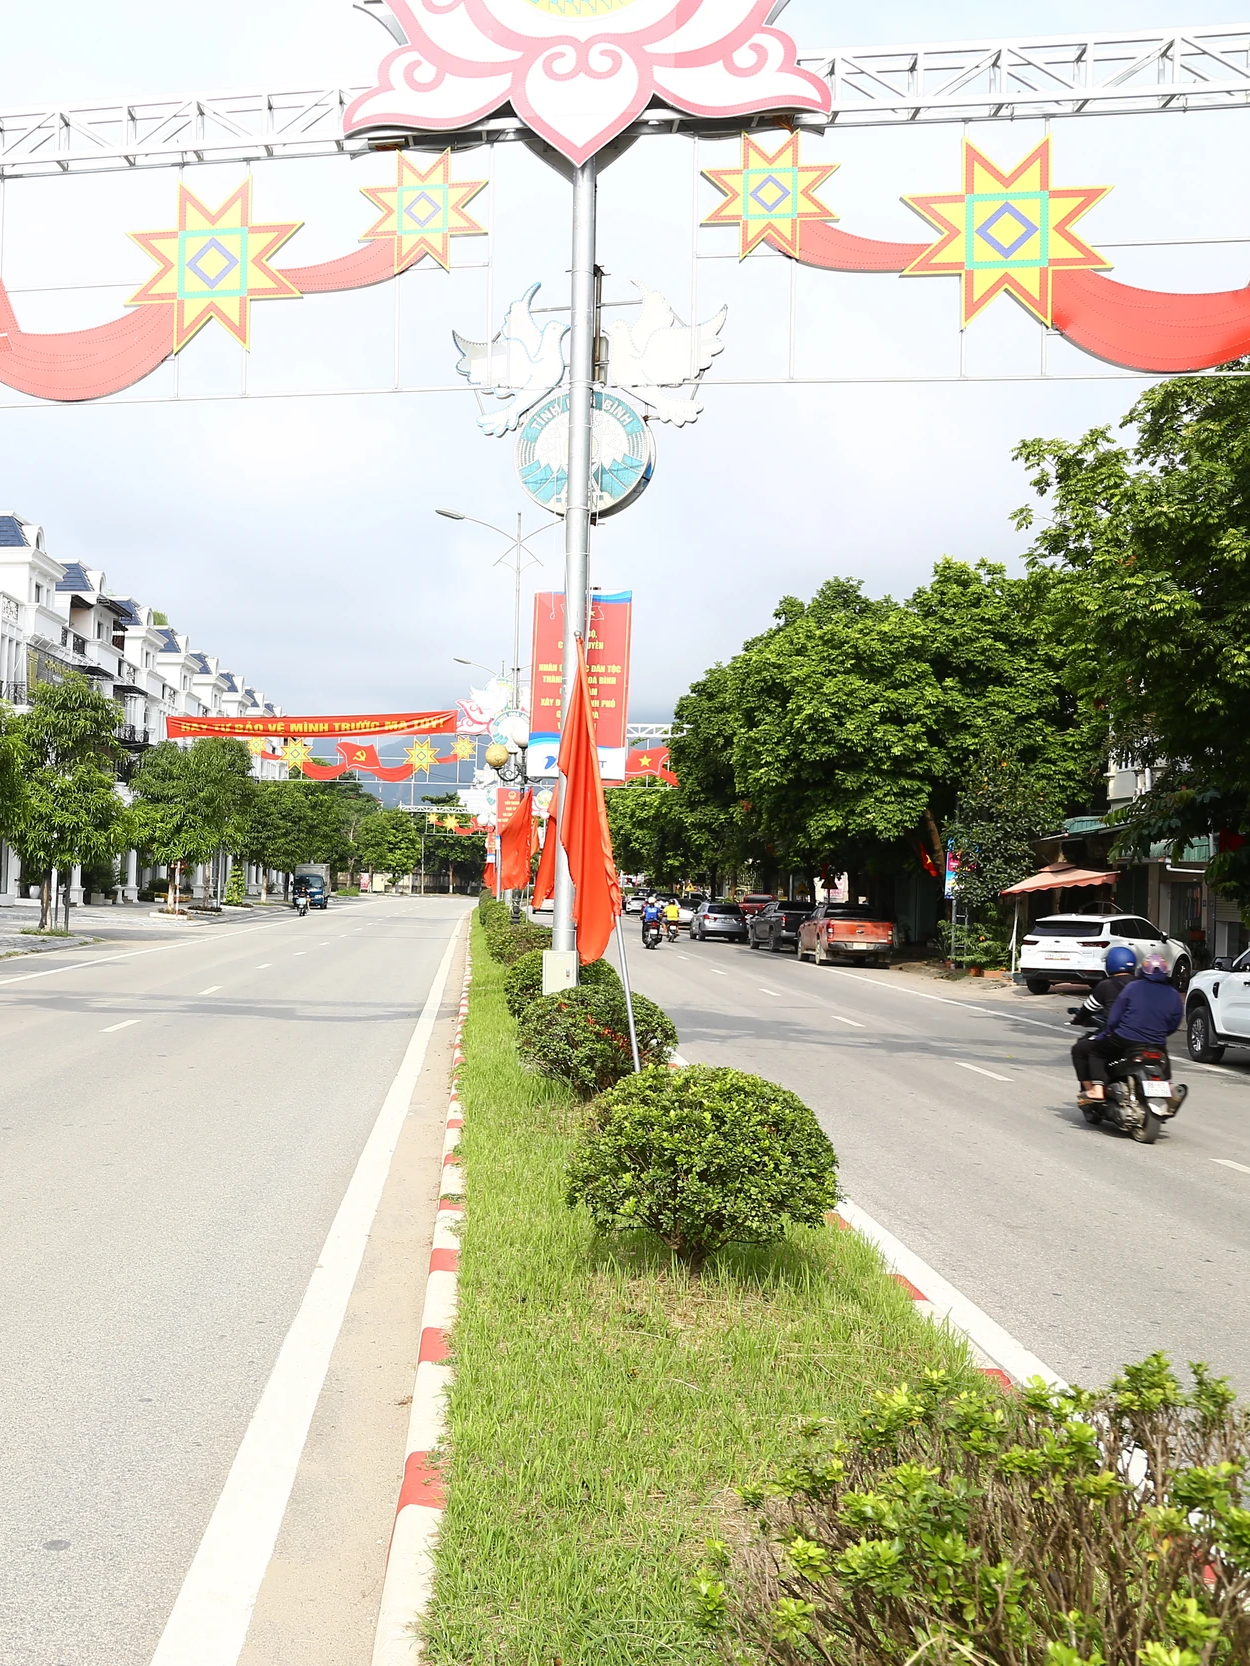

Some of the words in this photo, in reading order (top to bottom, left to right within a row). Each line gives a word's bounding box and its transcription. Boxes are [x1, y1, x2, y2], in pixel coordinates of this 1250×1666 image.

[604, 400, 633, 425] BÌNH
[599, 676, 617, 685] BÌNH
[267, 721, 285, 734] VỆ
[290, 722, 329, 733] MÌNH
[333, 719, 381, 732] TRƯỚC
